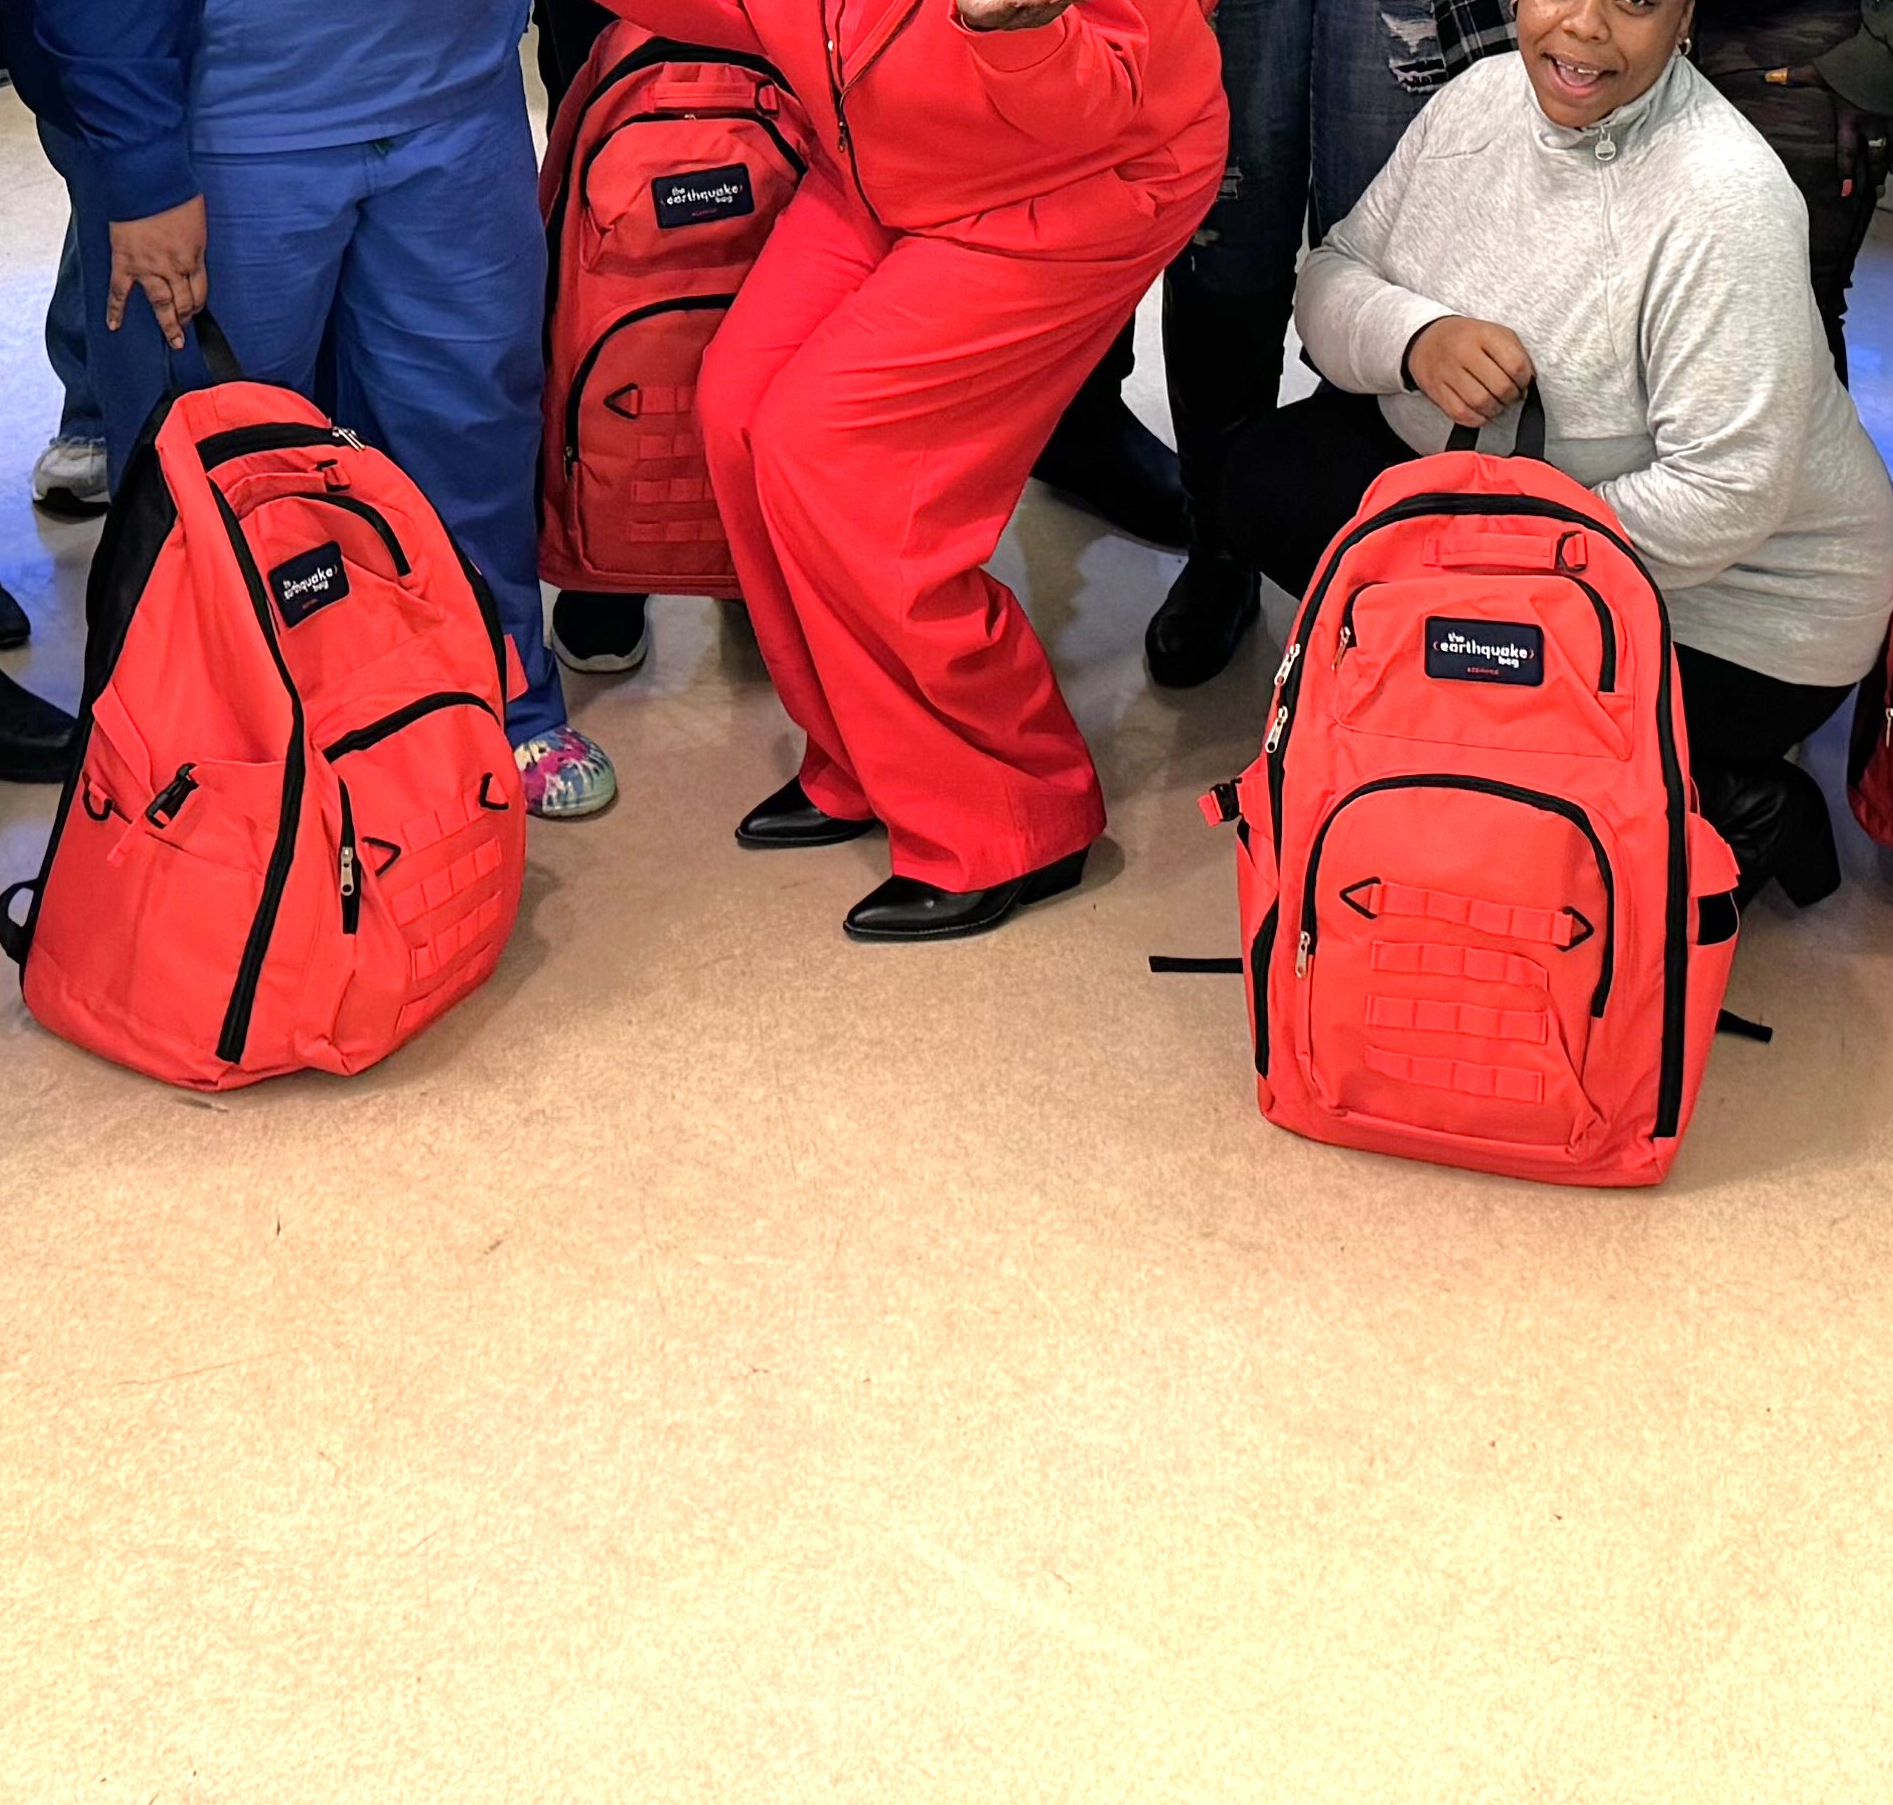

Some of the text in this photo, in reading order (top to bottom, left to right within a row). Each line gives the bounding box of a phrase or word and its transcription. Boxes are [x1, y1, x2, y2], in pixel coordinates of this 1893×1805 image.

[667, 182, 739, 205] earthquake
[1447, 631, 1465, 643] the
[1439, 639, 1528, 660] earthquake
[1498, 656, 1519, 669] bag
